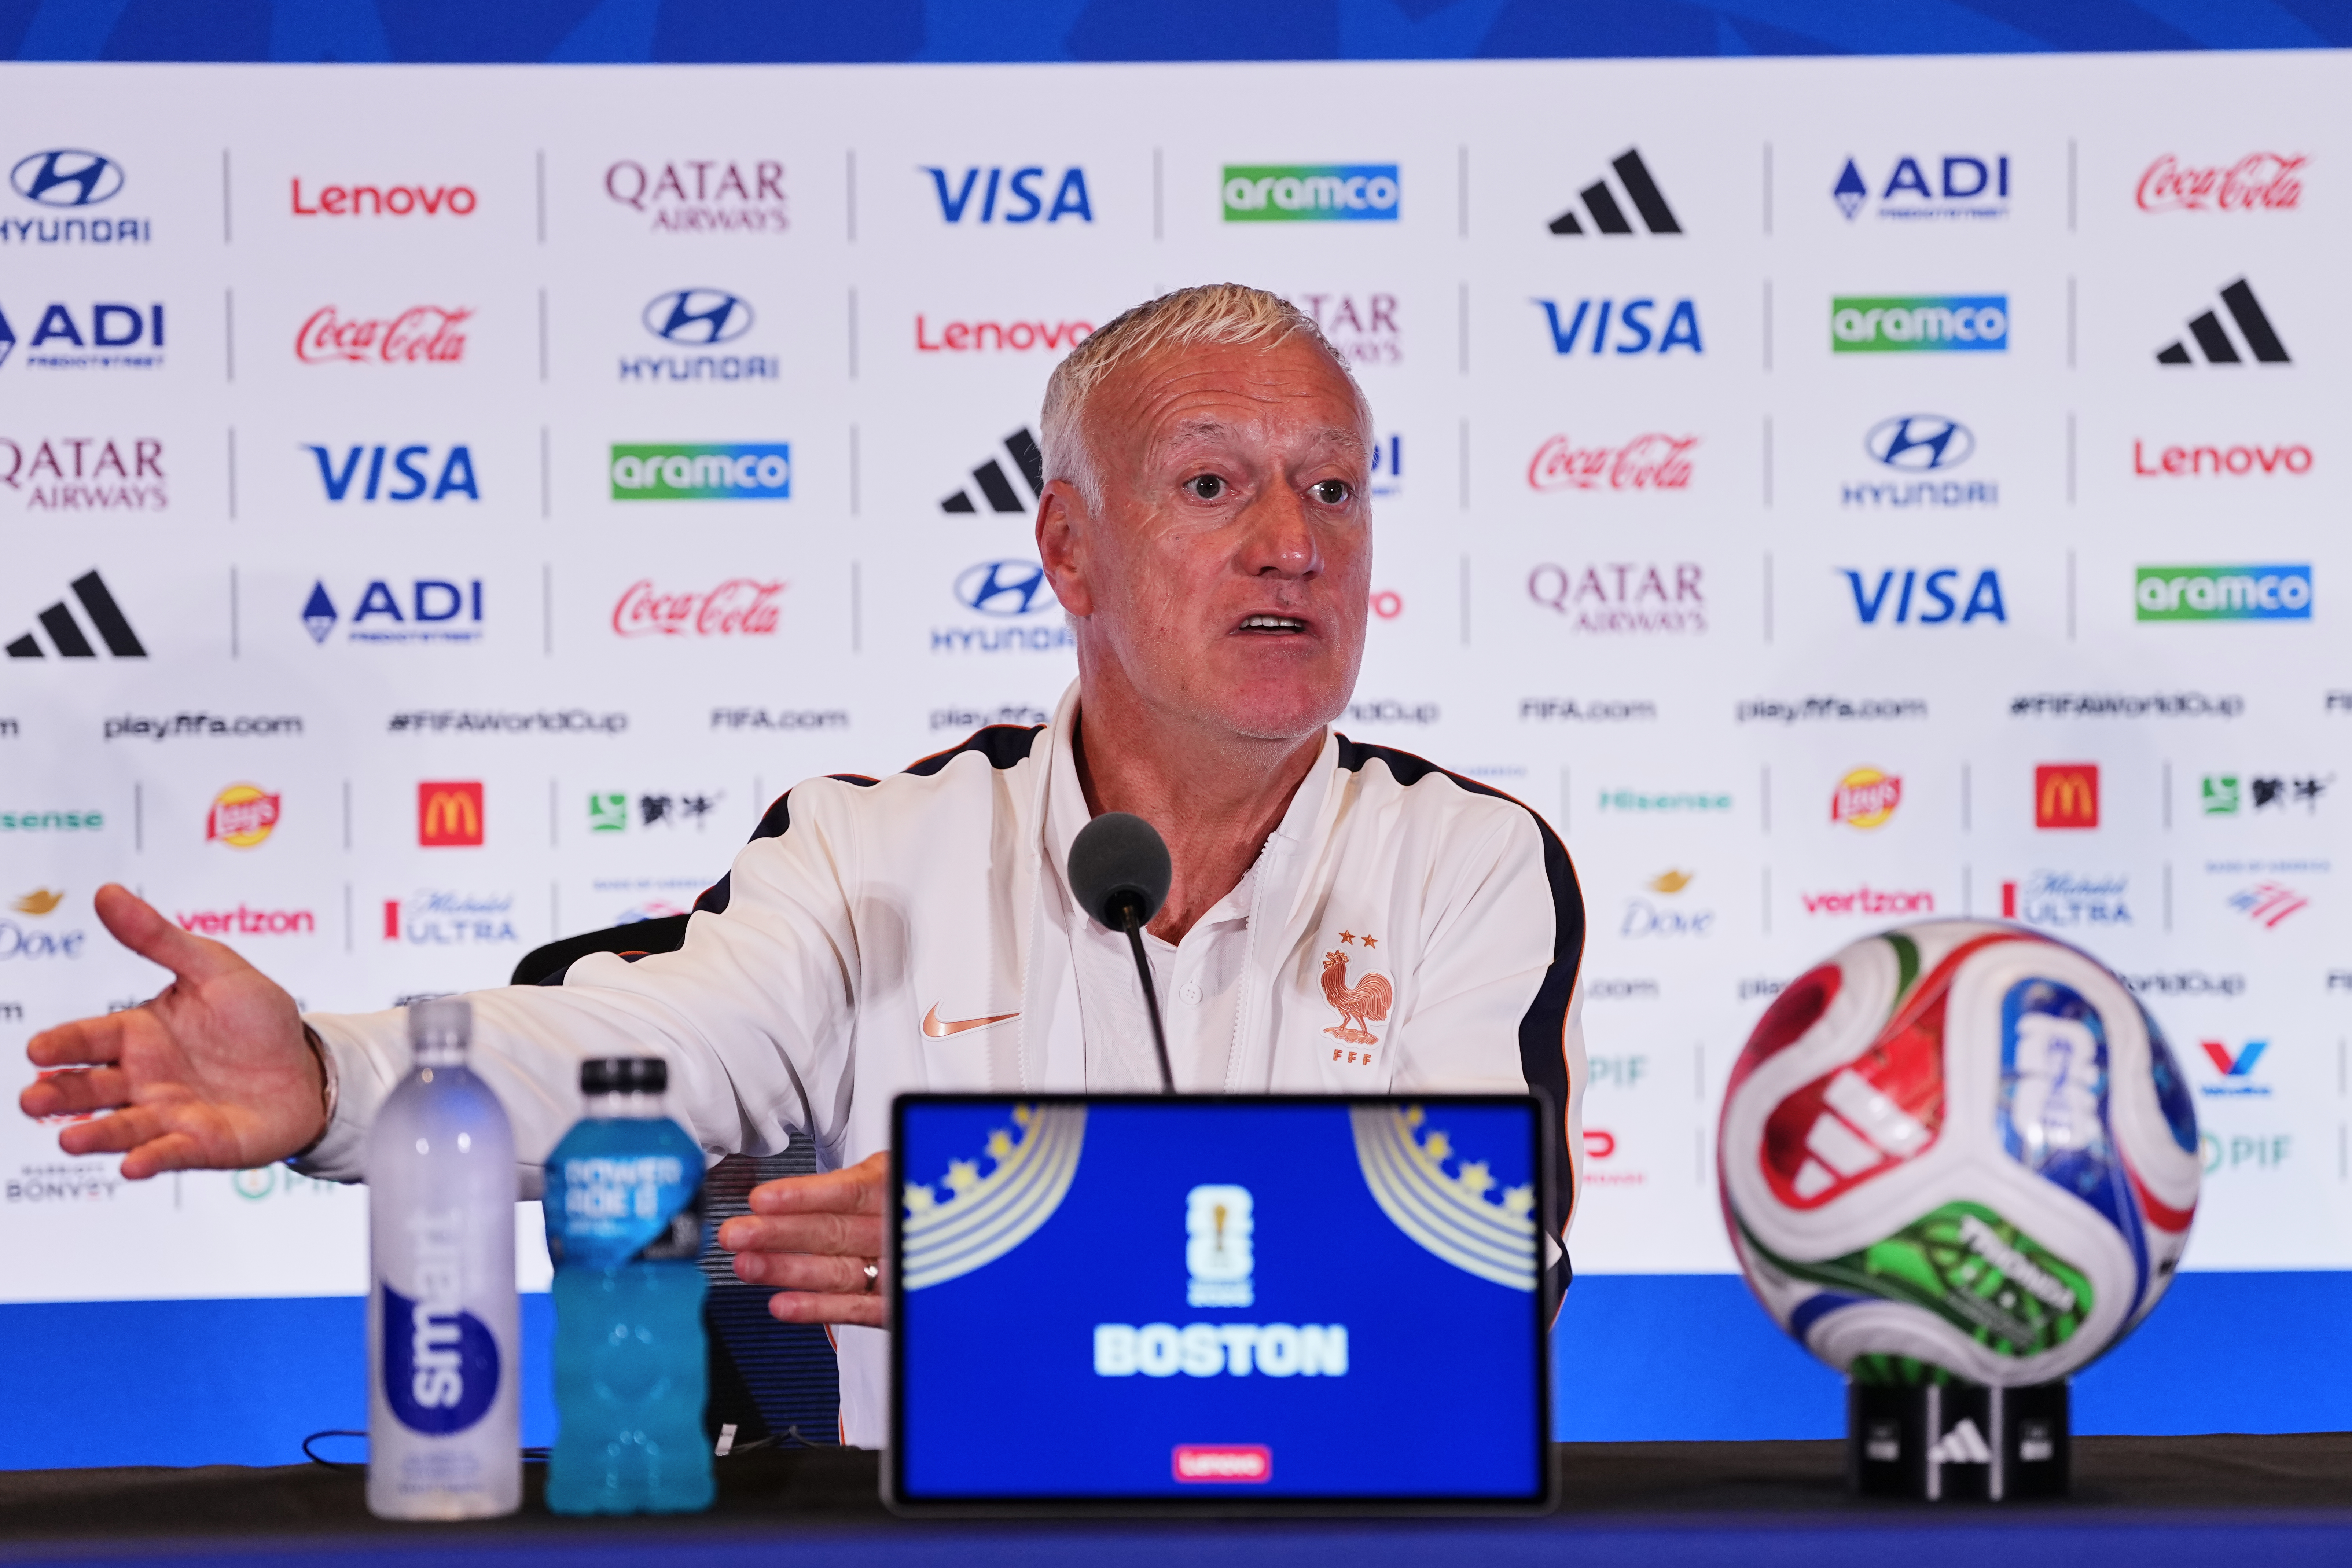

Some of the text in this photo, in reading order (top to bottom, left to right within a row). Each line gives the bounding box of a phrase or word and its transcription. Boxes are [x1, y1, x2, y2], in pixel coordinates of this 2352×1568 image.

[604, 161, 785, 209] QATAR
[1225, 177, 1396, 210] aramco
[1883, 156, 2009, 199] ADI
[291, 177, 477, 216] Lenovo
[922, 167, 1094, 224] VISA
[653, 206, 789, 232] AIRWAYS
[30, 304, 164, 347] ADI
[1309, 295, 1400, 333] TAR
[1535, 298, 1704, 355] VISA
[1835, 307, 2005, 341] aramco
[916, 315, 1094, 352] Lenovo
[619, 355, 779, 382] HYUNDAI
[304, 445, 480, 502] VISA
[613, 455, 788, 489] aramco
[2134, 440, 2314, 477] Lenovo
[28, 485, 168, 509] AIRWAYS
[1841, 481, 1998, 507] HYUNDAI
[352, 580, 483, 622] ADI
[1527, 563, 1705, 610] QATAR
[1837, 568, 2007, 625] VISA
[2138, 576, 2310, 611] aramco
[1577, 609, 1707, 633] AIRWAYS
[931, 626, 1074, 652] HYUNDA
[103, 712, 303, 740] play.fifa.com
[387, 710, 628, 734] #FIFAWorldCup
[710, 708, 848, 729] FIFA.com
[1519, 699, 1657, 720] FIFA.com
[1598, 790, 1732, 811] Hisense
[0, 811, 104, 830] sense
[1803, 886, 1934, 914] verizon
[2024, 901, 2131, 926] ULTRA
[177, 906, 315, 933] verizon
[406, 919, 518, 945] ULTRA
[2230, 1135, 2290, 1167] PIF
[410, 1207, 462, 1408] smart
[1094, 1323, 1349, 1377] BOSTON
